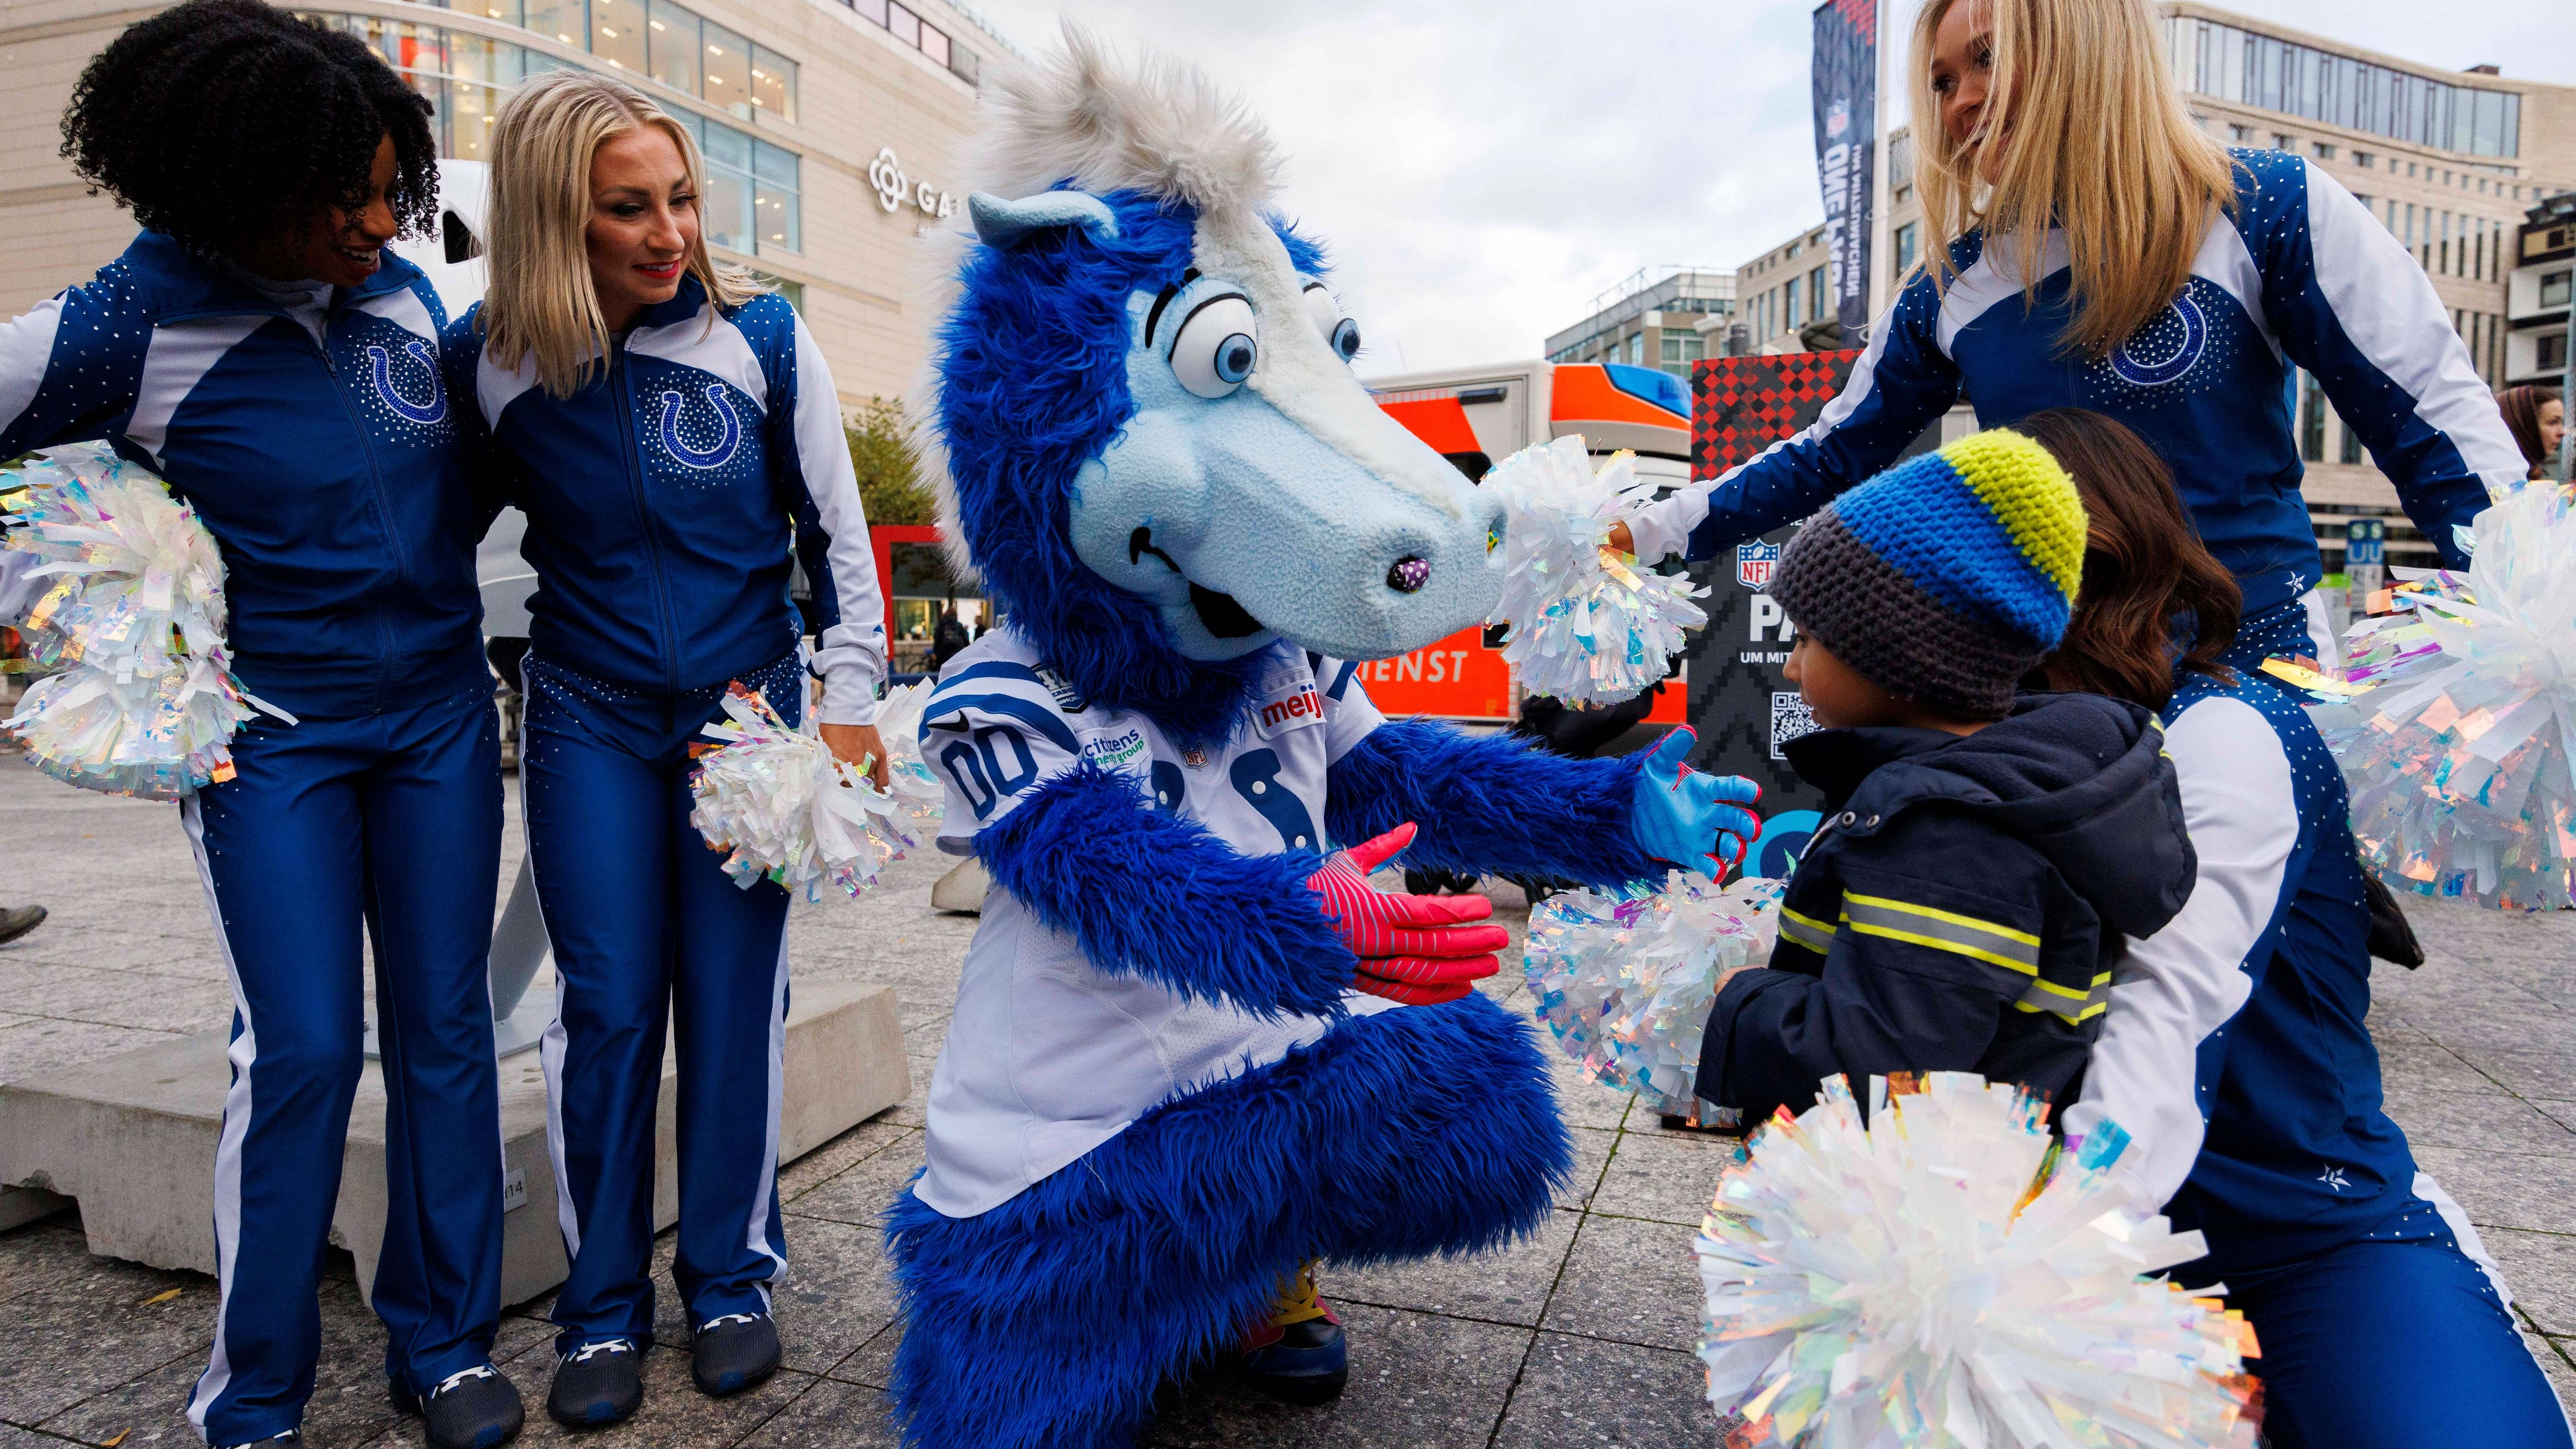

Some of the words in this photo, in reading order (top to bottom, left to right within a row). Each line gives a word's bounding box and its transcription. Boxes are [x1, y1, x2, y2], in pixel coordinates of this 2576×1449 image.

[1741, 652, 1763, 663] UM
[1262, 684, 1323, 727] meij
[1084, 729, 1139, 757] citizens
[1117, 740, 1144, 763] group
[1185, 751, 1206, 764] NFL
[941, 725, 1039, 821] 00
